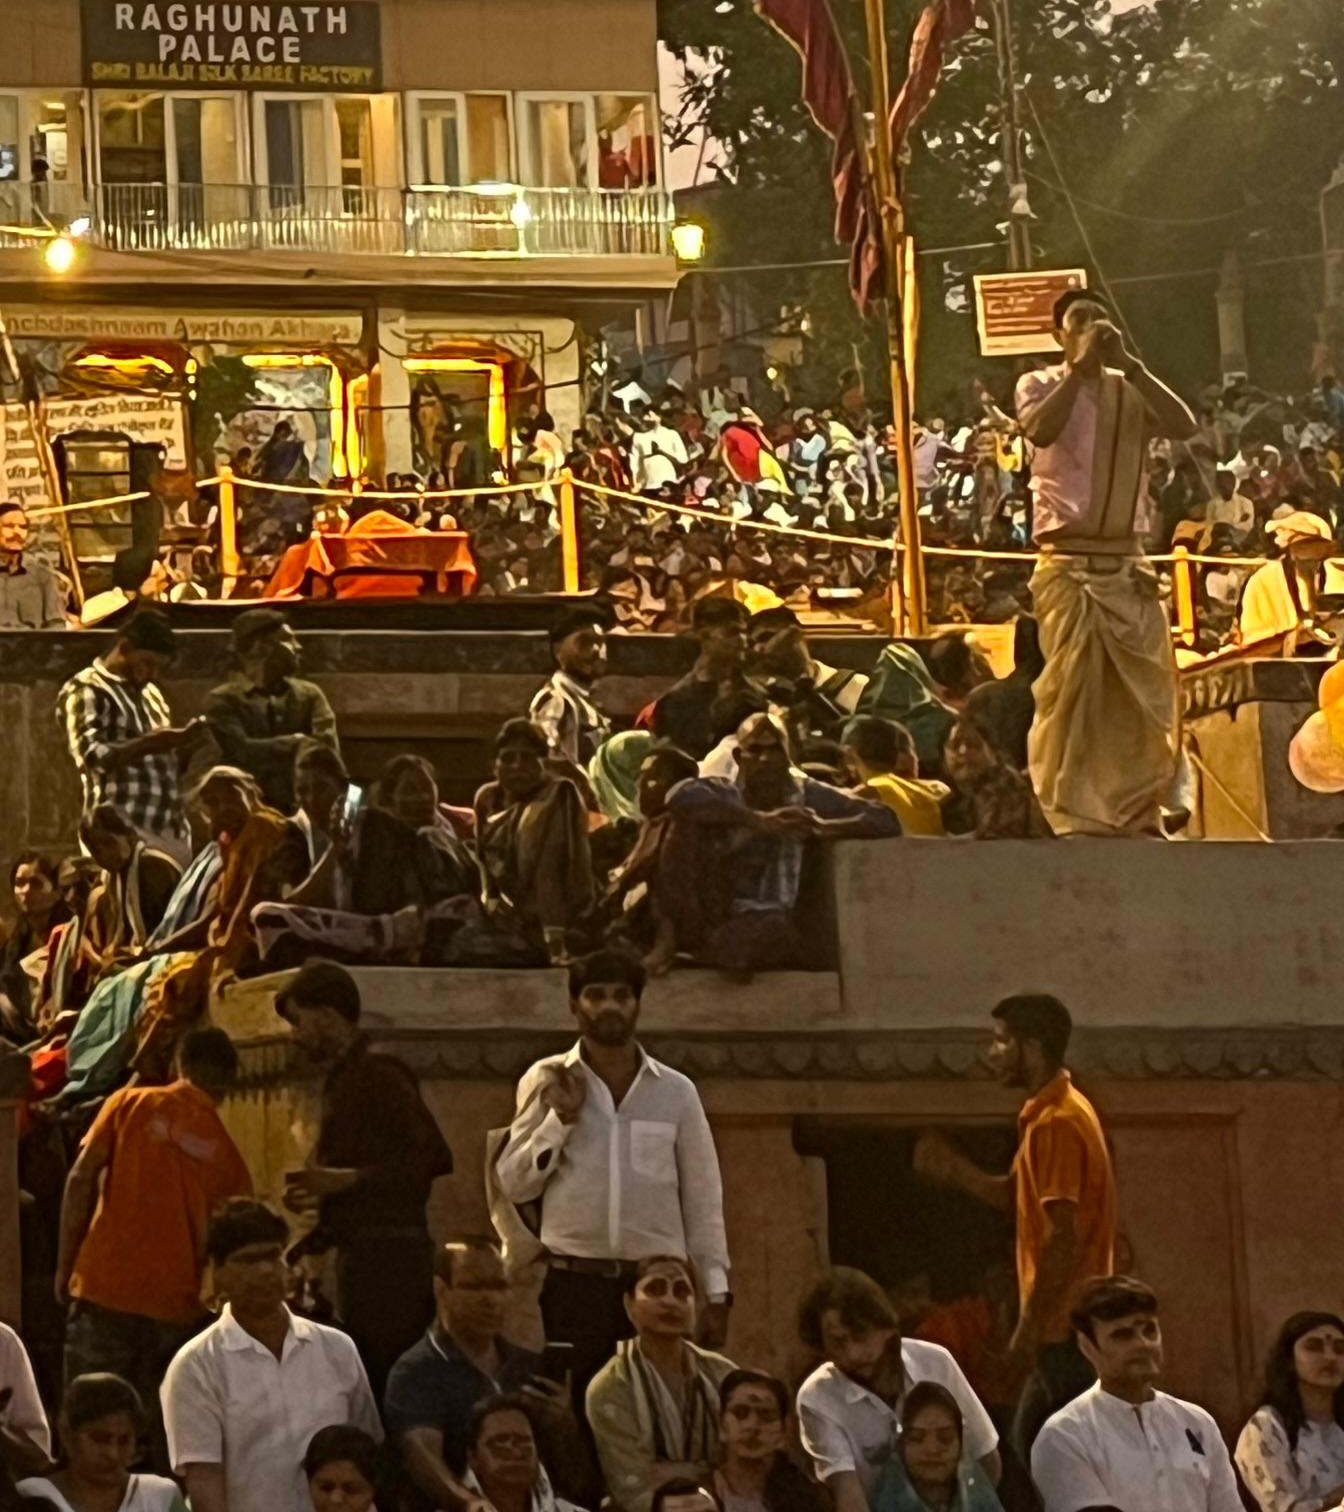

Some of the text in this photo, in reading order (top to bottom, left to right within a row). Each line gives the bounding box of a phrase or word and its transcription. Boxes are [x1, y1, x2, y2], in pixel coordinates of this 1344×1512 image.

[115, 3, 348, 34] RAGHUNATH
[158, 34, 302, 63] PALACE
[300, 66, 374, 85] FACTORY
